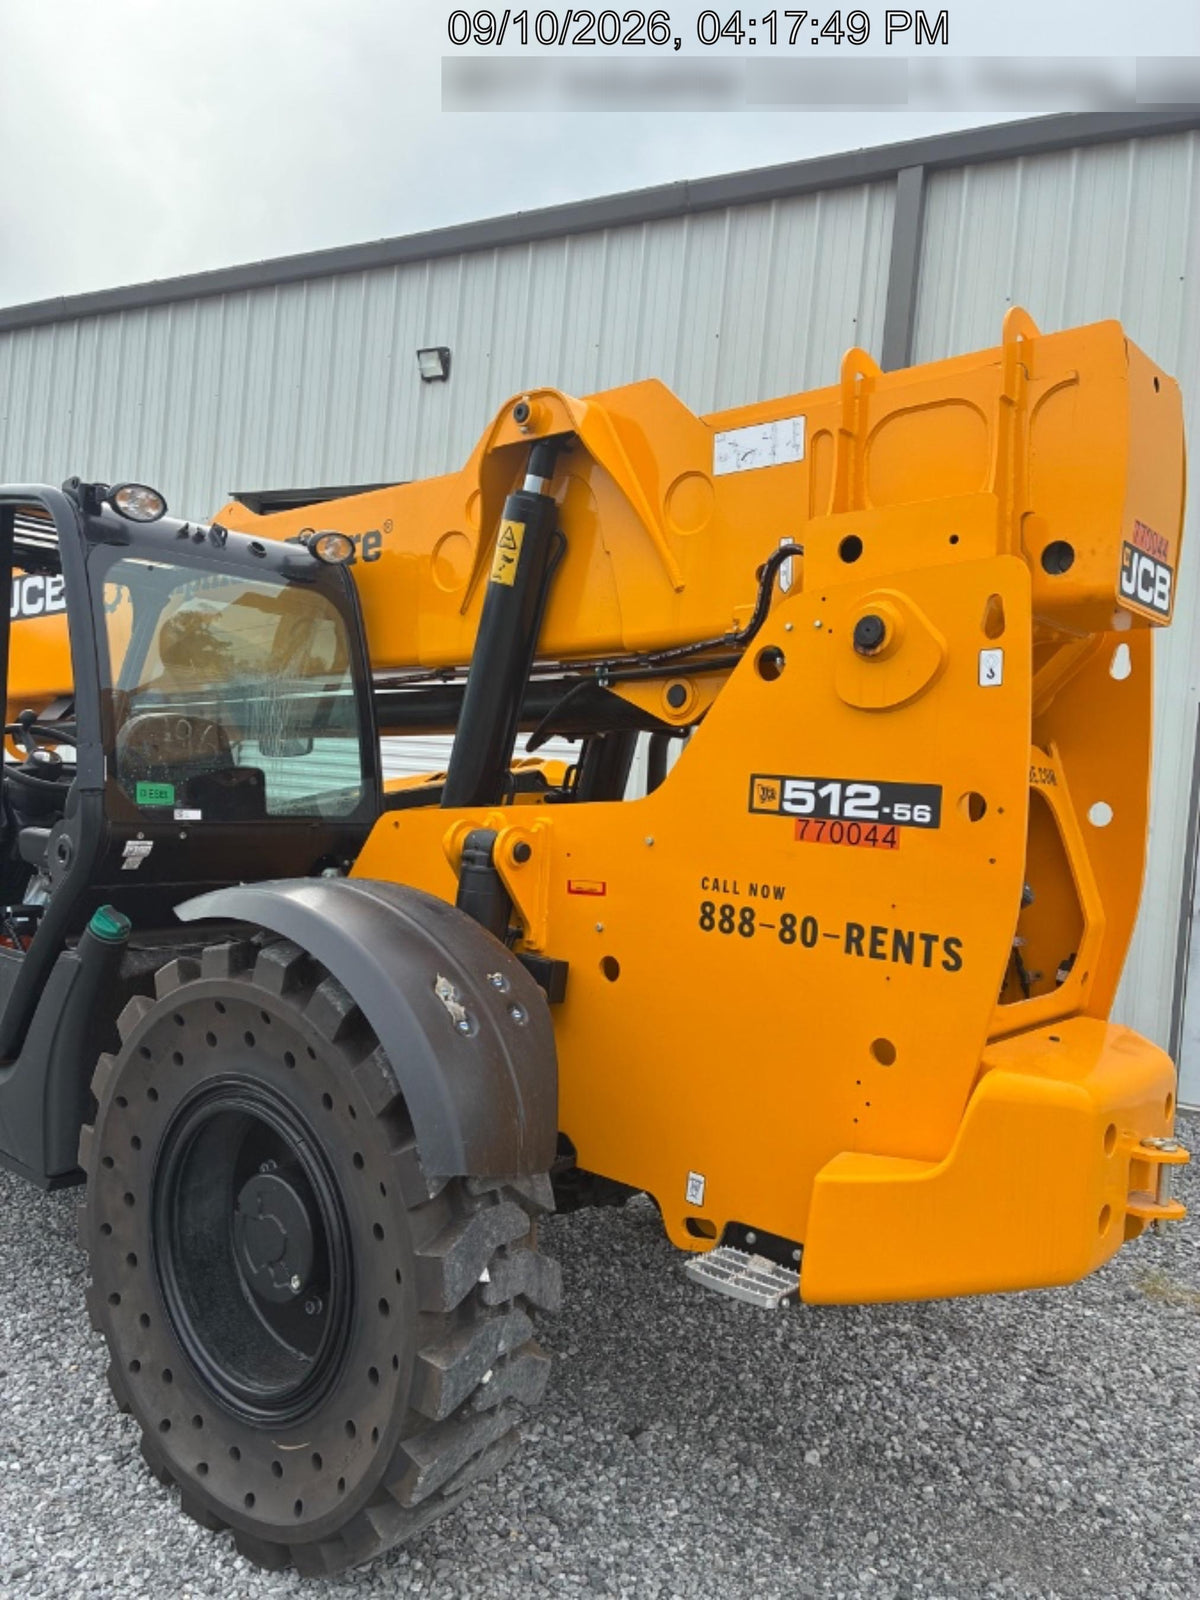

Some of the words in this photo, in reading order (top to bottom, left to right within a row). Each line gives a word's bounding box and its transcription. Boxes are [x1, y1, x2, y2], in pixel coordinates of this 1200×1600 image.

[1121, 552, 1171, 610] JCB
[797, 818, 896, 848] 770044
[701, 876, 740, 895] CALL
[749, 882, 786, 900] NOW
[699, 900, 963, 972] 888-80-RENTS
